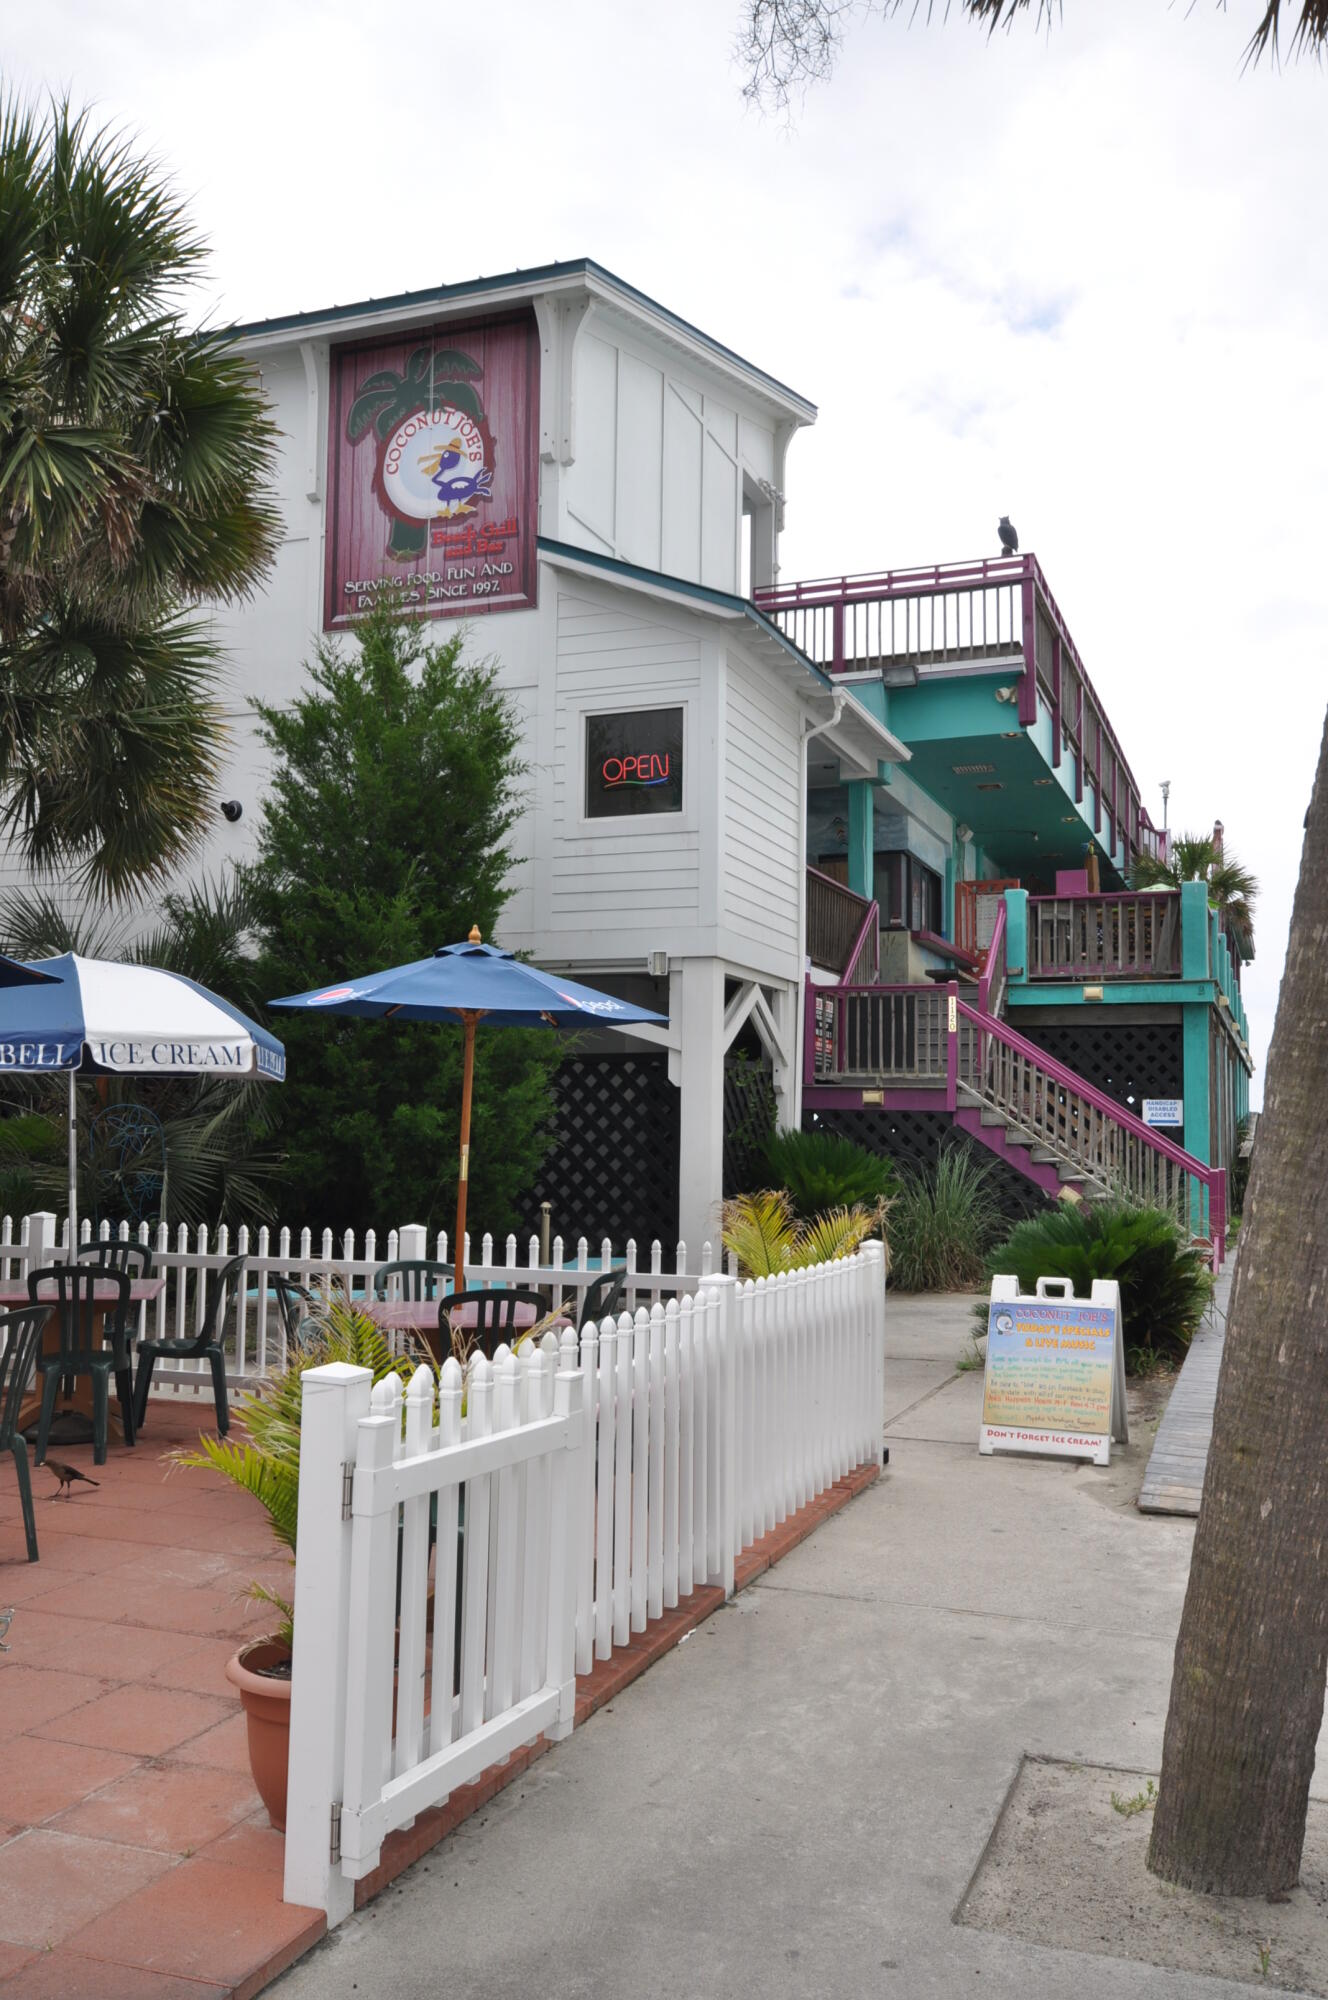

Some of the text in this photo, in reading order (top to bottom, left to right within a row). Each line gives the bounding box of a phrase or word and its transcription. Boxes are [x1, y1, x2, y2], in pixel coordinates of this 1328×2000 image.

[386, 407, 482, 475] COCONUT JOE'S
[447, 566, 476, 581] FUN
[481, 562, 513, 577] AND
[428, 583, 468, 600] SINCE
[602, 753, 669, 782] OPEN
[0, 1043, 74, 1066] BELL
[99, 1042, 144, 1066] ICE
[149, 1044, 243, 1066] CREAM
[1015, 1309, 1071, 1321] COCONUT
[1061, 1325, 1111, 1338] SPECIALS
[1035, 1337, 1059, 1349] LIVE
[1060, 1339, 1096, 1350] MUSIC
[987, 1429, 1014, 1439] DON'T
[1016, 1432, 1050, 1442] FORGET
[1052, 1435, 1065, 1443] ICE
